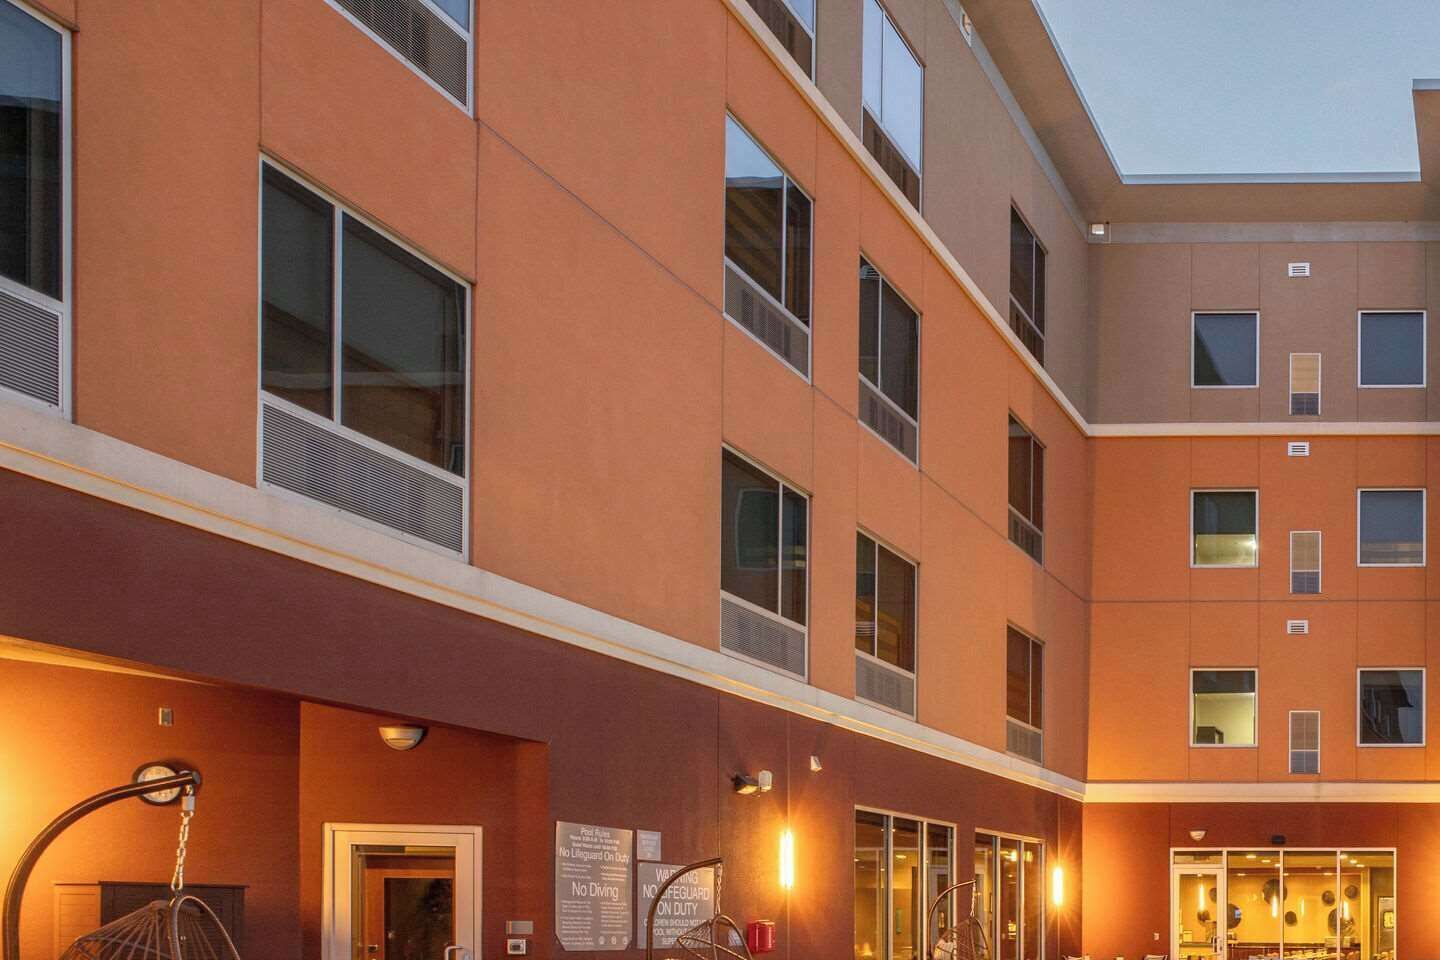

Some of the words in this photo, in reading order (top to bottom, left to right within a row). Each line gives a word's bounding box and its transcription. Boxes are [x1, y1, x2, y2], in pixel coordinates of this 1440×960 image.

[560, 847, 570, 858] No
[571, 848, 603, 861] Lifeguard
[604, 850, 614, 862] On
[615, 852, 630, 864] Duty
[572, 881, 587, 897] No
[589, 882, 619, 902] Diving
[643, 884, 658, 899] NO
[657, 901, 672, 915] ON
[674, 902, 698, 916] DUTY
